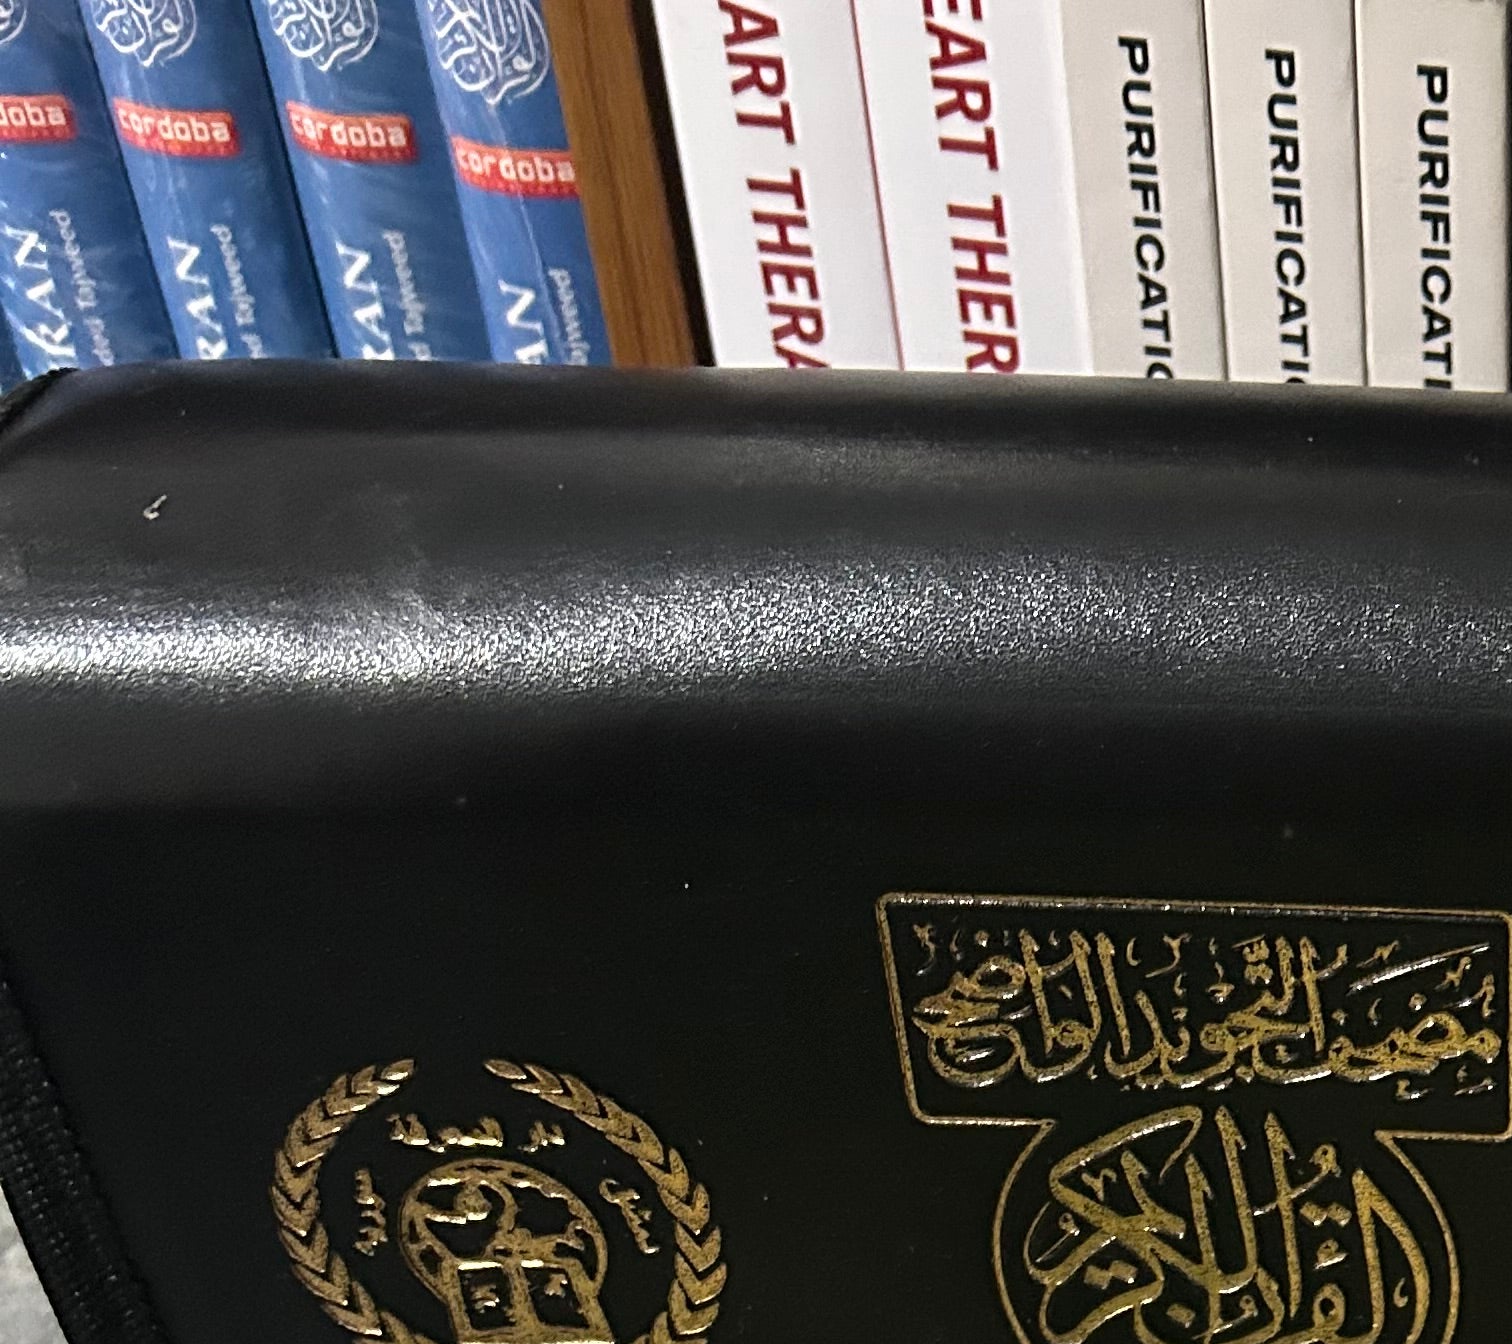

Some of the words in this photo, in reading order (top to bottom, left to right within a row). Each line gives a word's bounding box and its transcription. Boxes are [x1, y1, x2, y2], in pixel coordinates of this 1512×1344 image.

[0, 101, 67, 127] doba
[116, 106, 232, 143] cordoba
[290, 111, 407, 148] cordoba
[455, 147, 576, 183] cordoba
[946, 194, 1022, 374] THER
